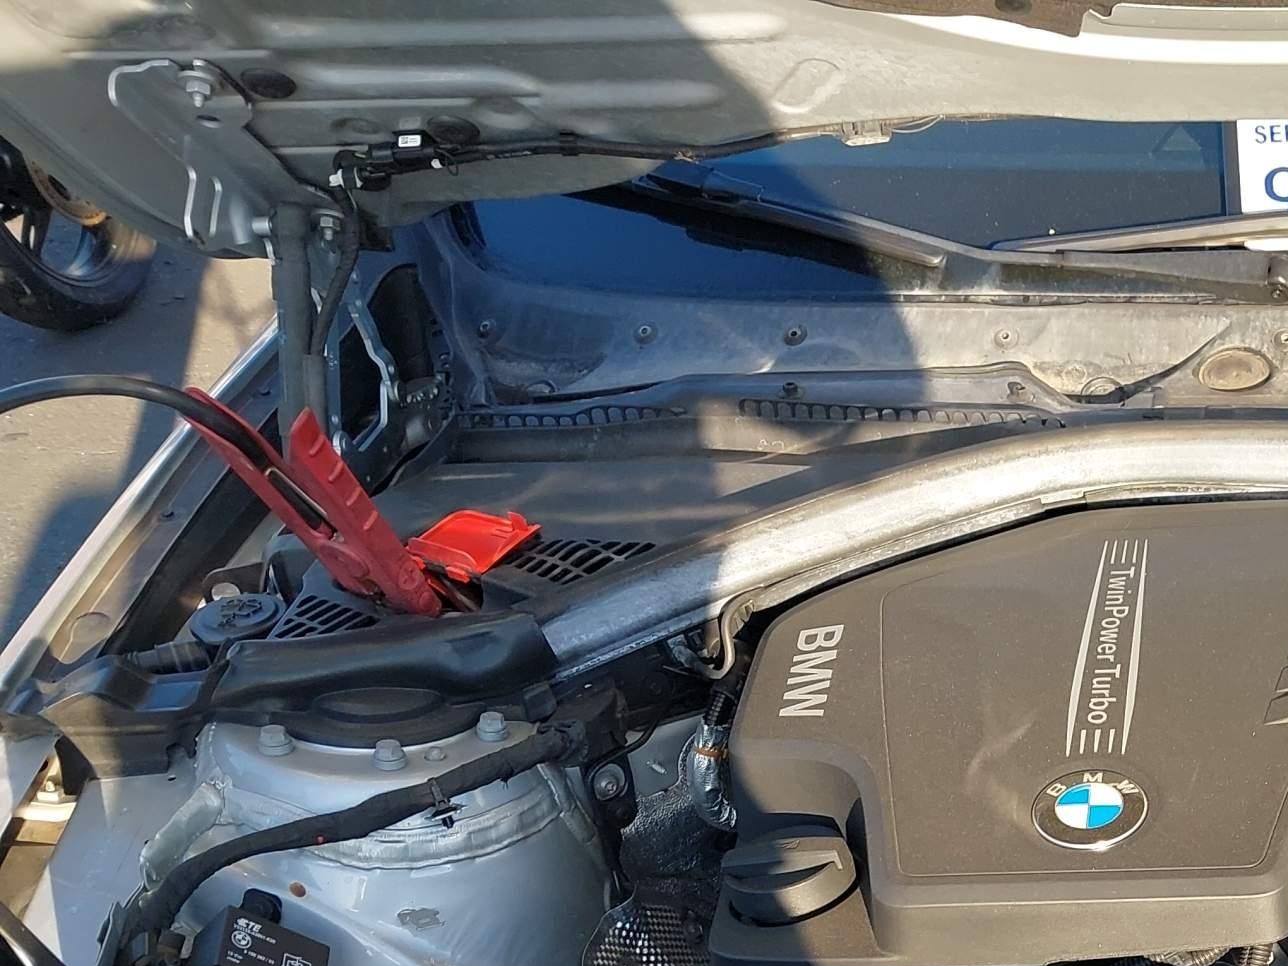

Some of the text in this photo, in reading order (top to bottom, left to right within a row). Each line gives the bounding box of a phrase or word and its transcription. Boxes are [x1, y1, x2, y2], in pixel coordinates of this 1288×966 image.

[779, 624, 845, 718] BMW
[1087, 566, 1135, 725] TwinPower Turbo
[1046, 772, 1139, 797] BMW
